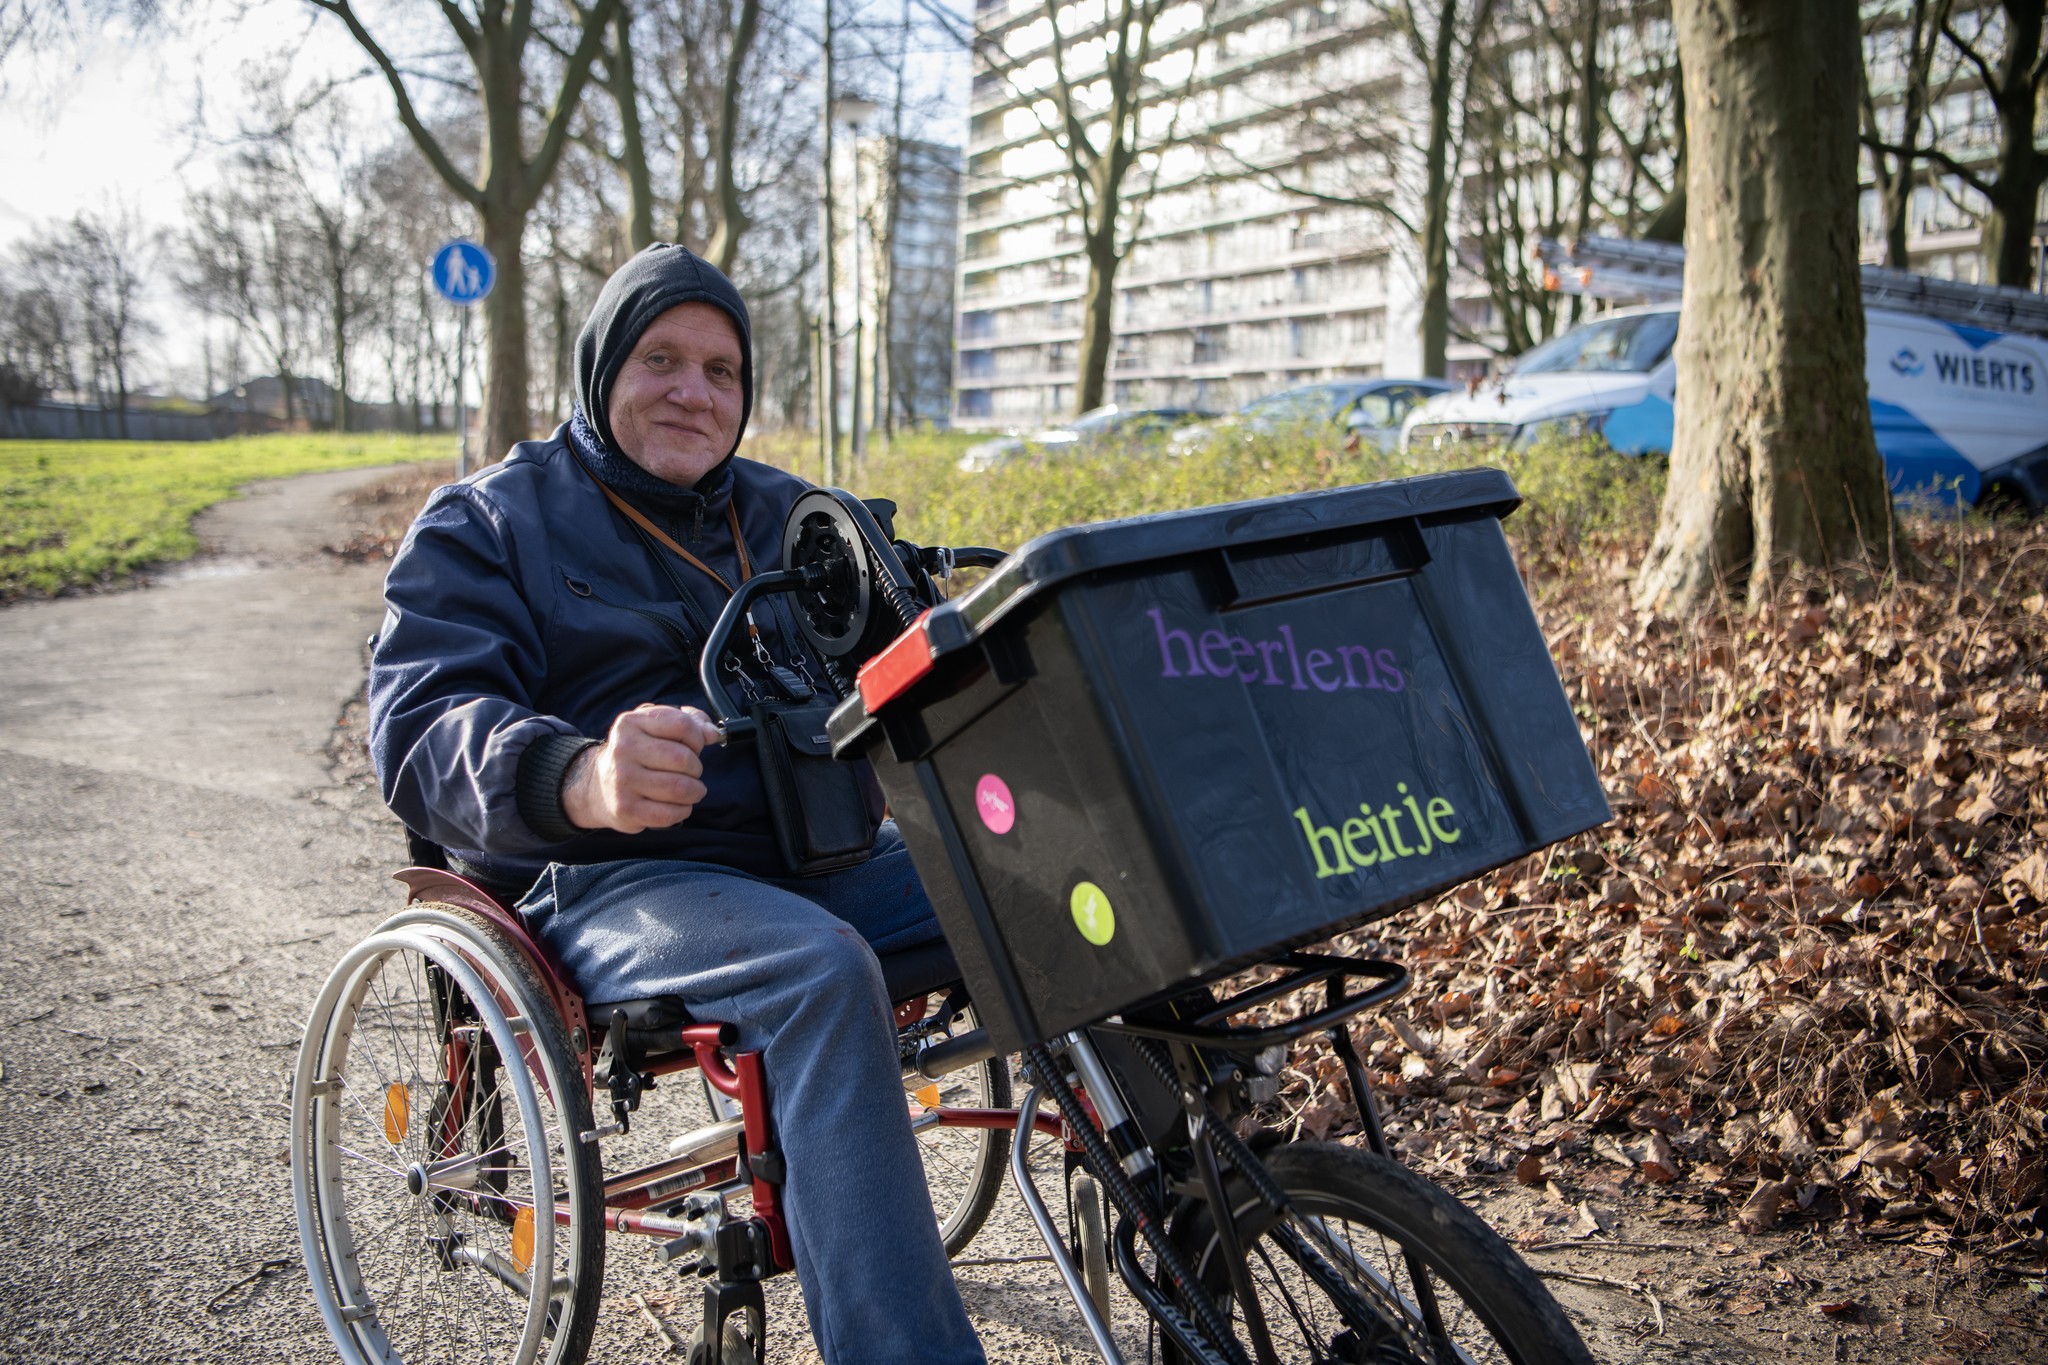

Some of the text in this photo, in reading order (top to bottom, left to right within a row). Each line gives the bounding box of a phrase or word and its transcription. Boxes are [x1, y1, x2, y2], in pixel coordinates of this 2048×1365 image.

[1934, 352, 2035, 395] WIERTS
[1147, 607, 1405, 693] heerlens
[1293, 782, 1461, 879] heitje
